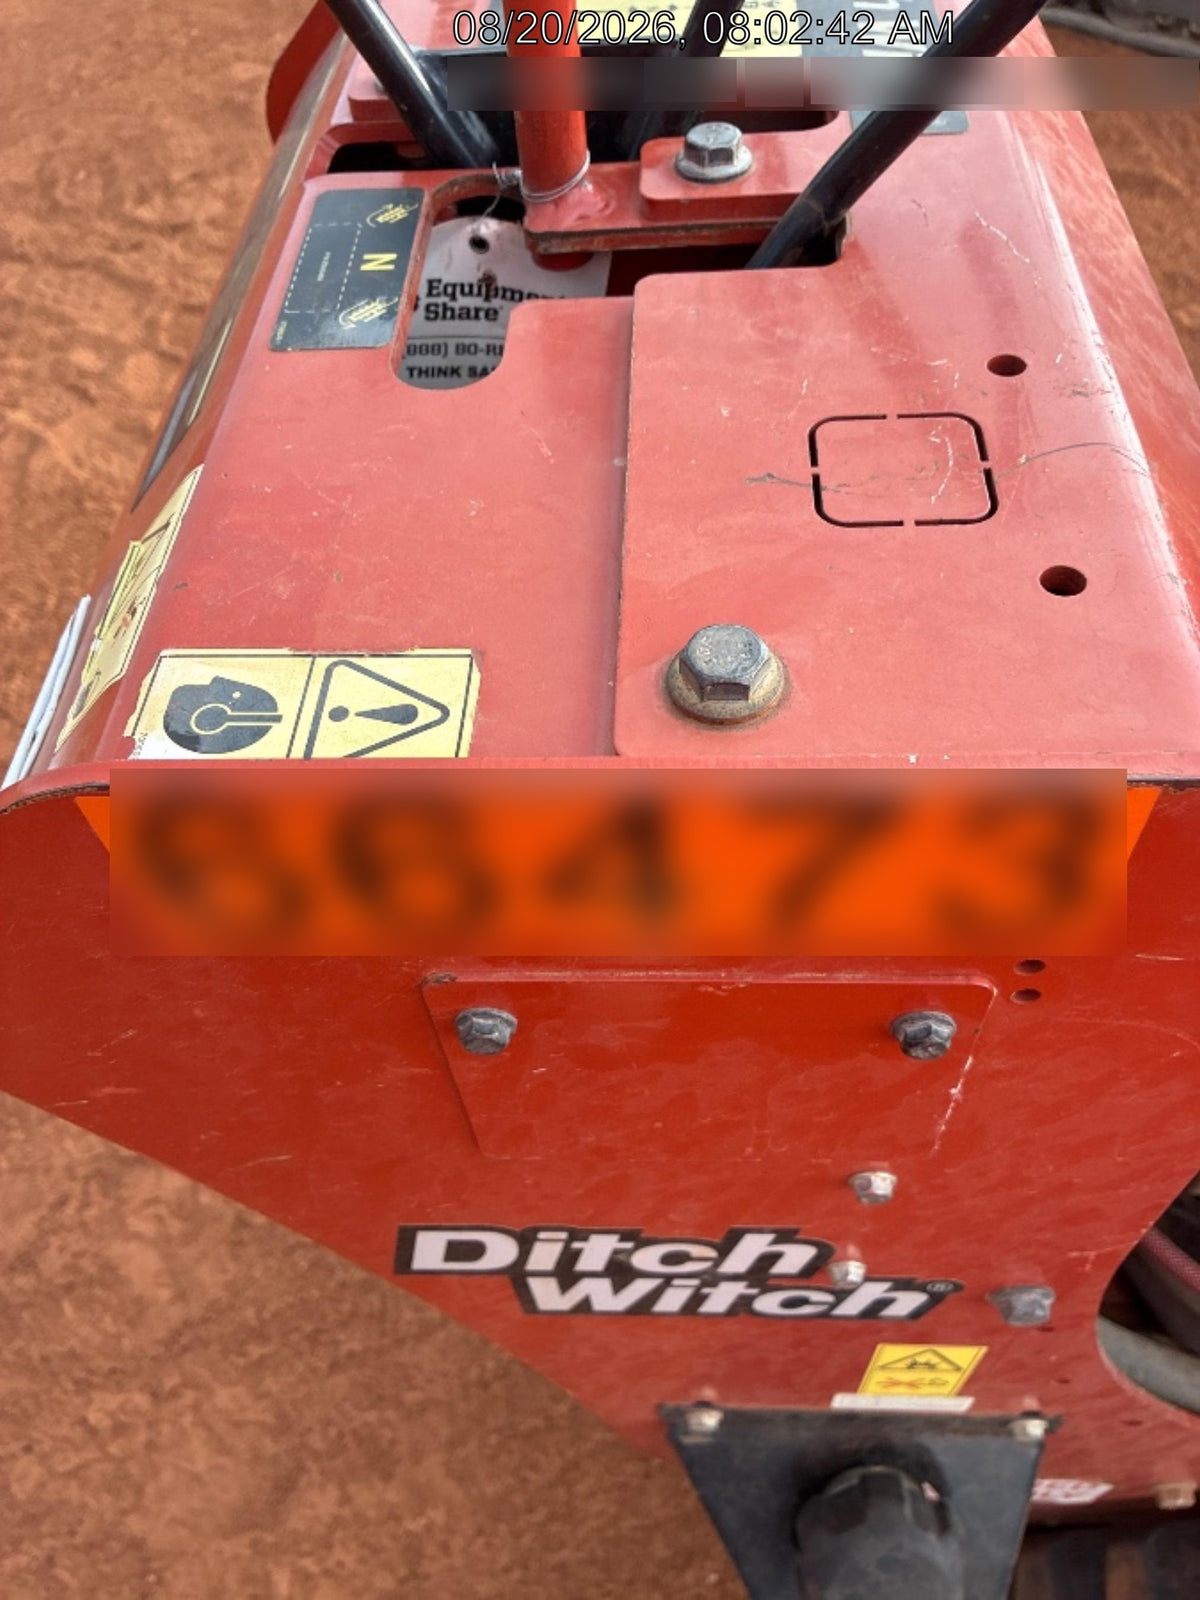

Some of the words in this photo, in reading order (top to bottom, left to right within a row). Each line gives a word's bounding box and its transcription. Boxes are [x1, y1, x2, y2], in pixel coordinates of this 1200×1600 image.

[360, 253, 398, 271] N
[426, 278, 566, 302] Equipm
[424, 302, 499, 322] Share
[406, 366, 462, 378] THINK
[468, 366, 497, 378] SA
[411, 1229, 818, 1275] Ditch
